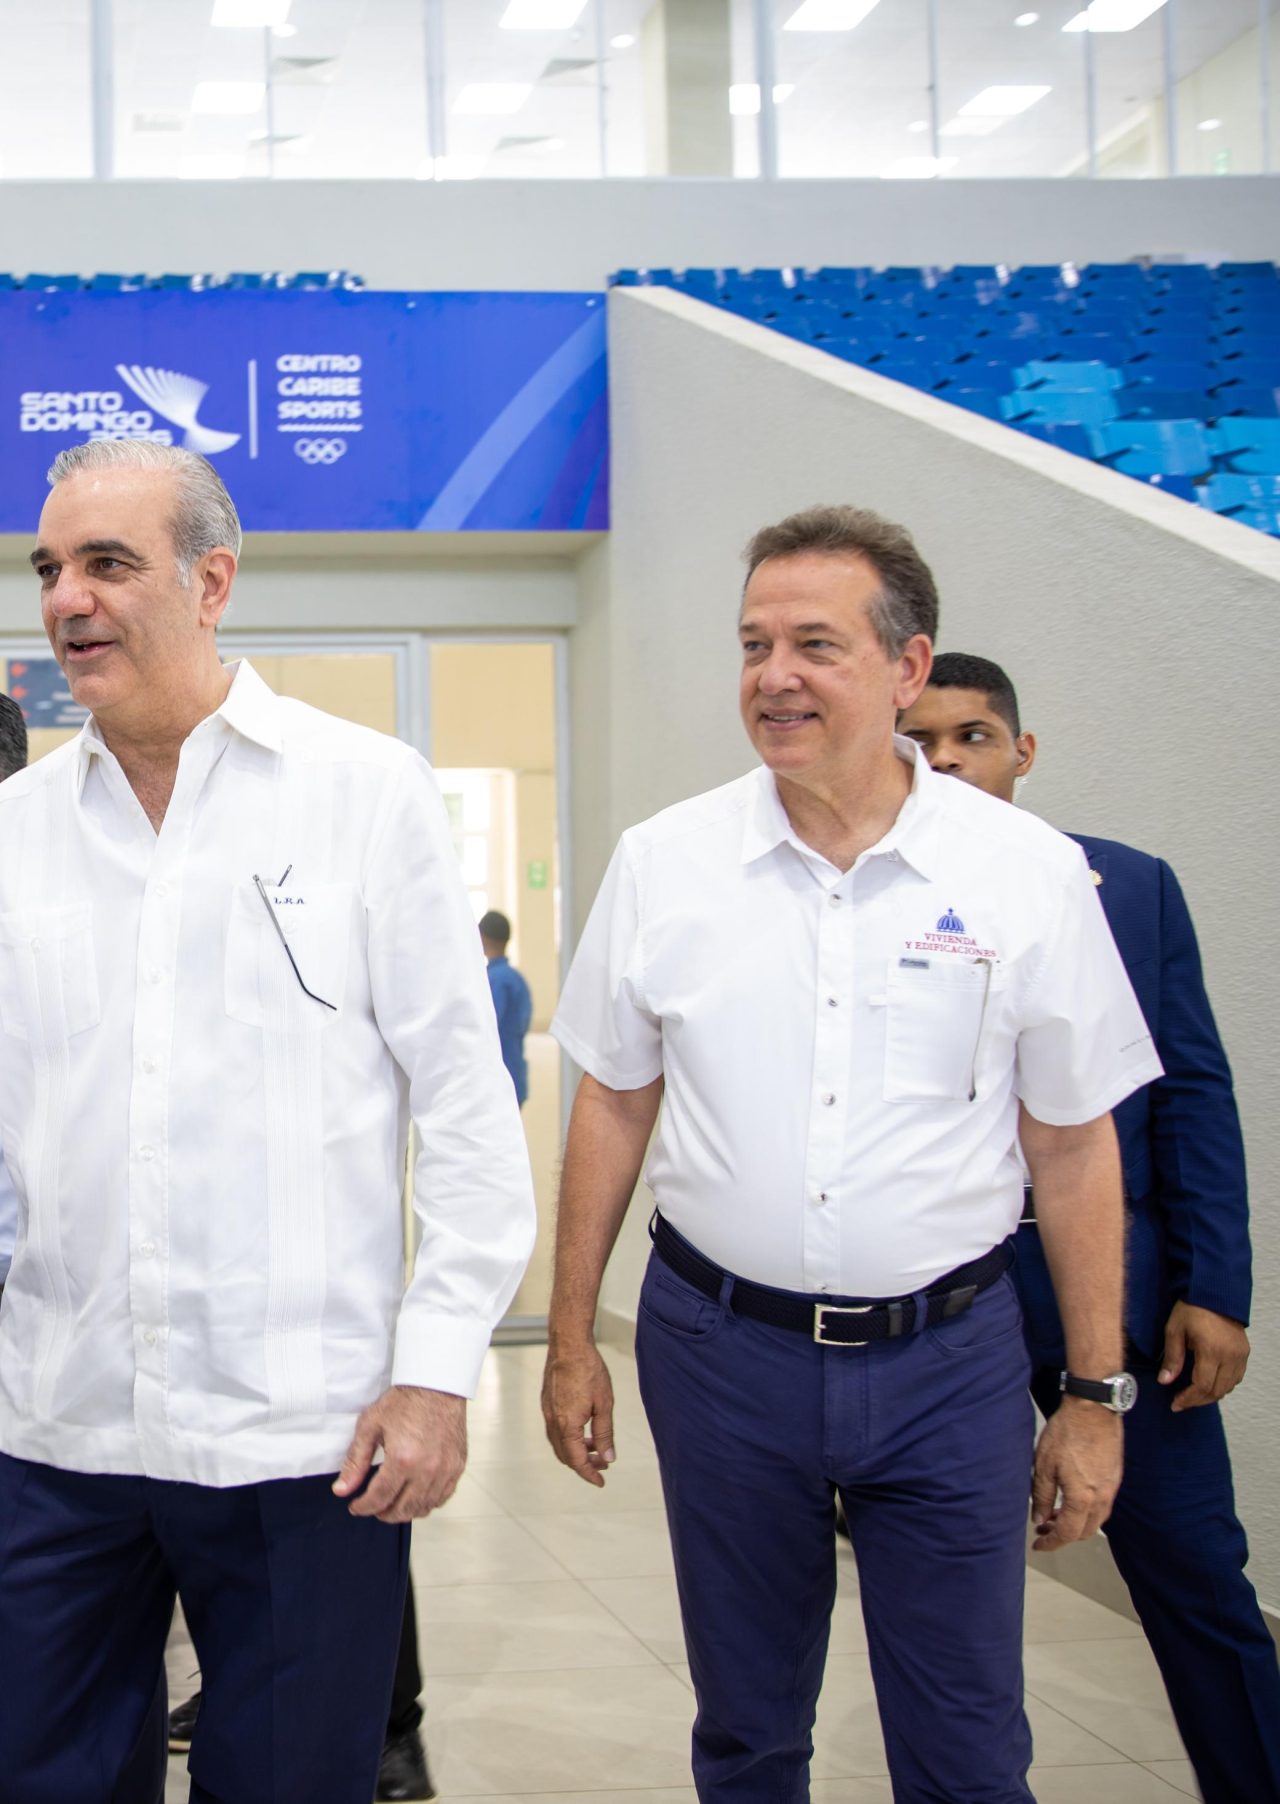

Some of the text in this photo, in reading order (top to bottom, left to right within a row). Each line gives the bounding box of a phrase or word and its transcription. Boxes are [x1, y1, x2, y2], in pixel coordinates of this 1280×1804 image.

[277, 355, 361, 372] CENTRO
[278, 377, 361, 396] CARIBE
[21, 391, 122, 412] SANTO
[278, 401, 362, 419] SPORTS
[21, 411, 152, 431] DOMINGO
[924, 933, 977, 946] VIVIENDA
[905, 941, 996, 957] Y EDIFICACIONES
